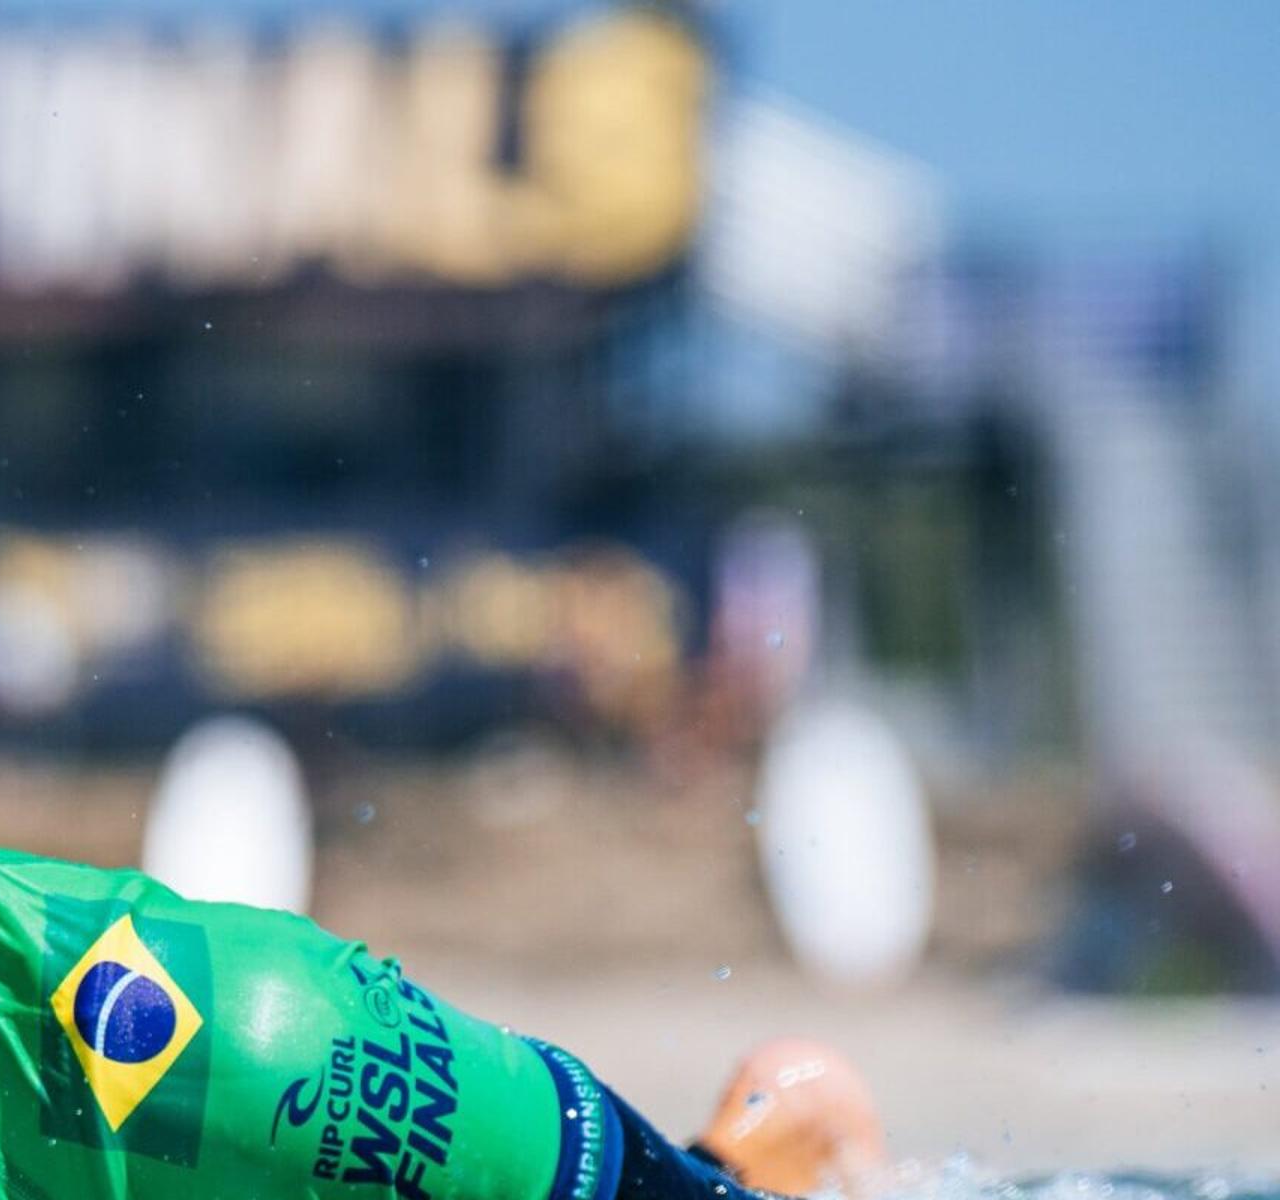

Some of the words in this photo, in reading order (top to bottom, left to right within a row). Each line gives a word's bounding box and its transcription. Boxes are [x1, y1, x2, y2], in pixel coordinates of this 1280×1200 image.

[326, 1036, 356, 1122] CURL
[342, 1032, 412, 1187] WSL
[312, 1123, 345, 1181] RIP
